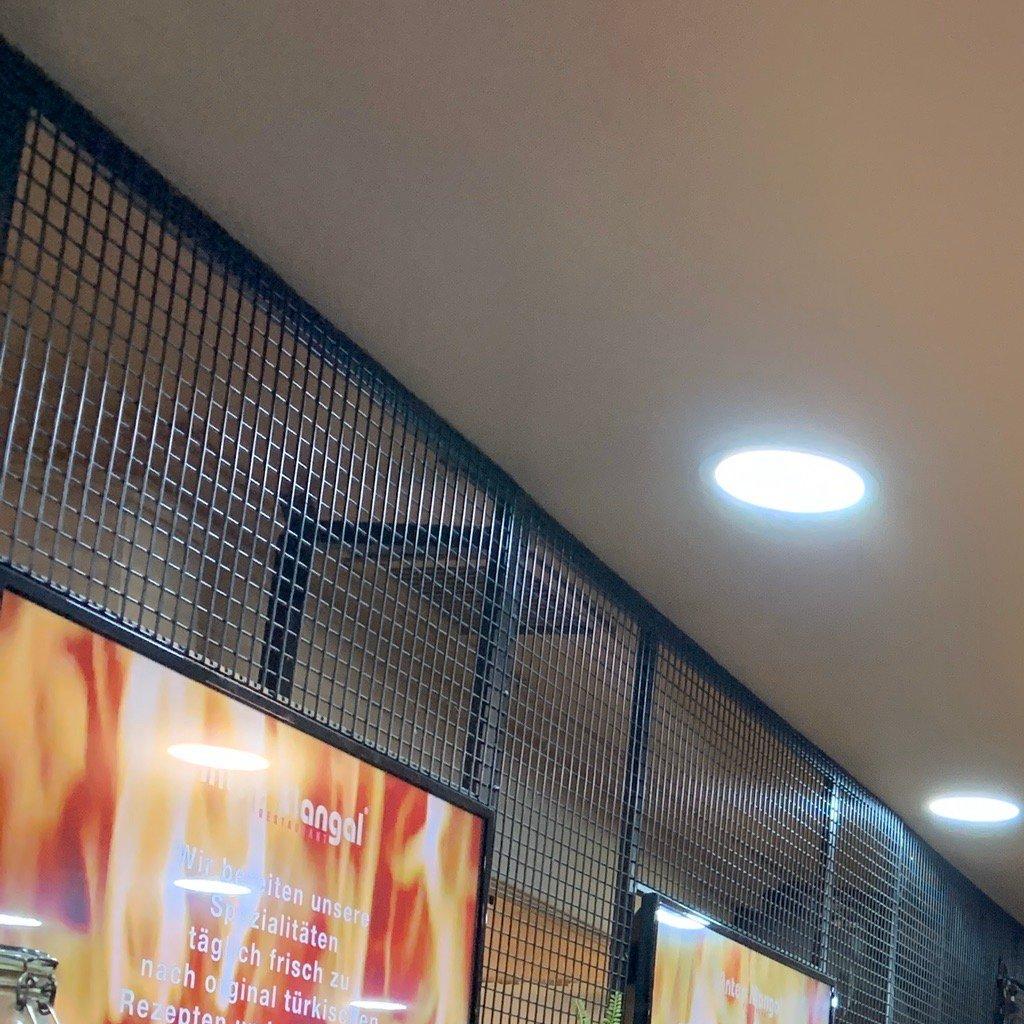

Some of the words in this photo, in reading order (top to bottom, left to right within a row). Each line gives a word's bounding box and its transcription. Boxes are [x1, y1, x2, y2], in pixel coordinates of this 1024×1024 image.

[210, 894, 338, 954] Spzialitäten
[222, 857, 303, 907] beiten
[311, 892, 370, 929] unsere
[141, 957, 196, 989] nach
[205, 973, 277, 1009] oginal
[189, 926, 261, 967] täglch
[269, 948, 323, 984] frisch
[330, 970, 350, 992] zu
